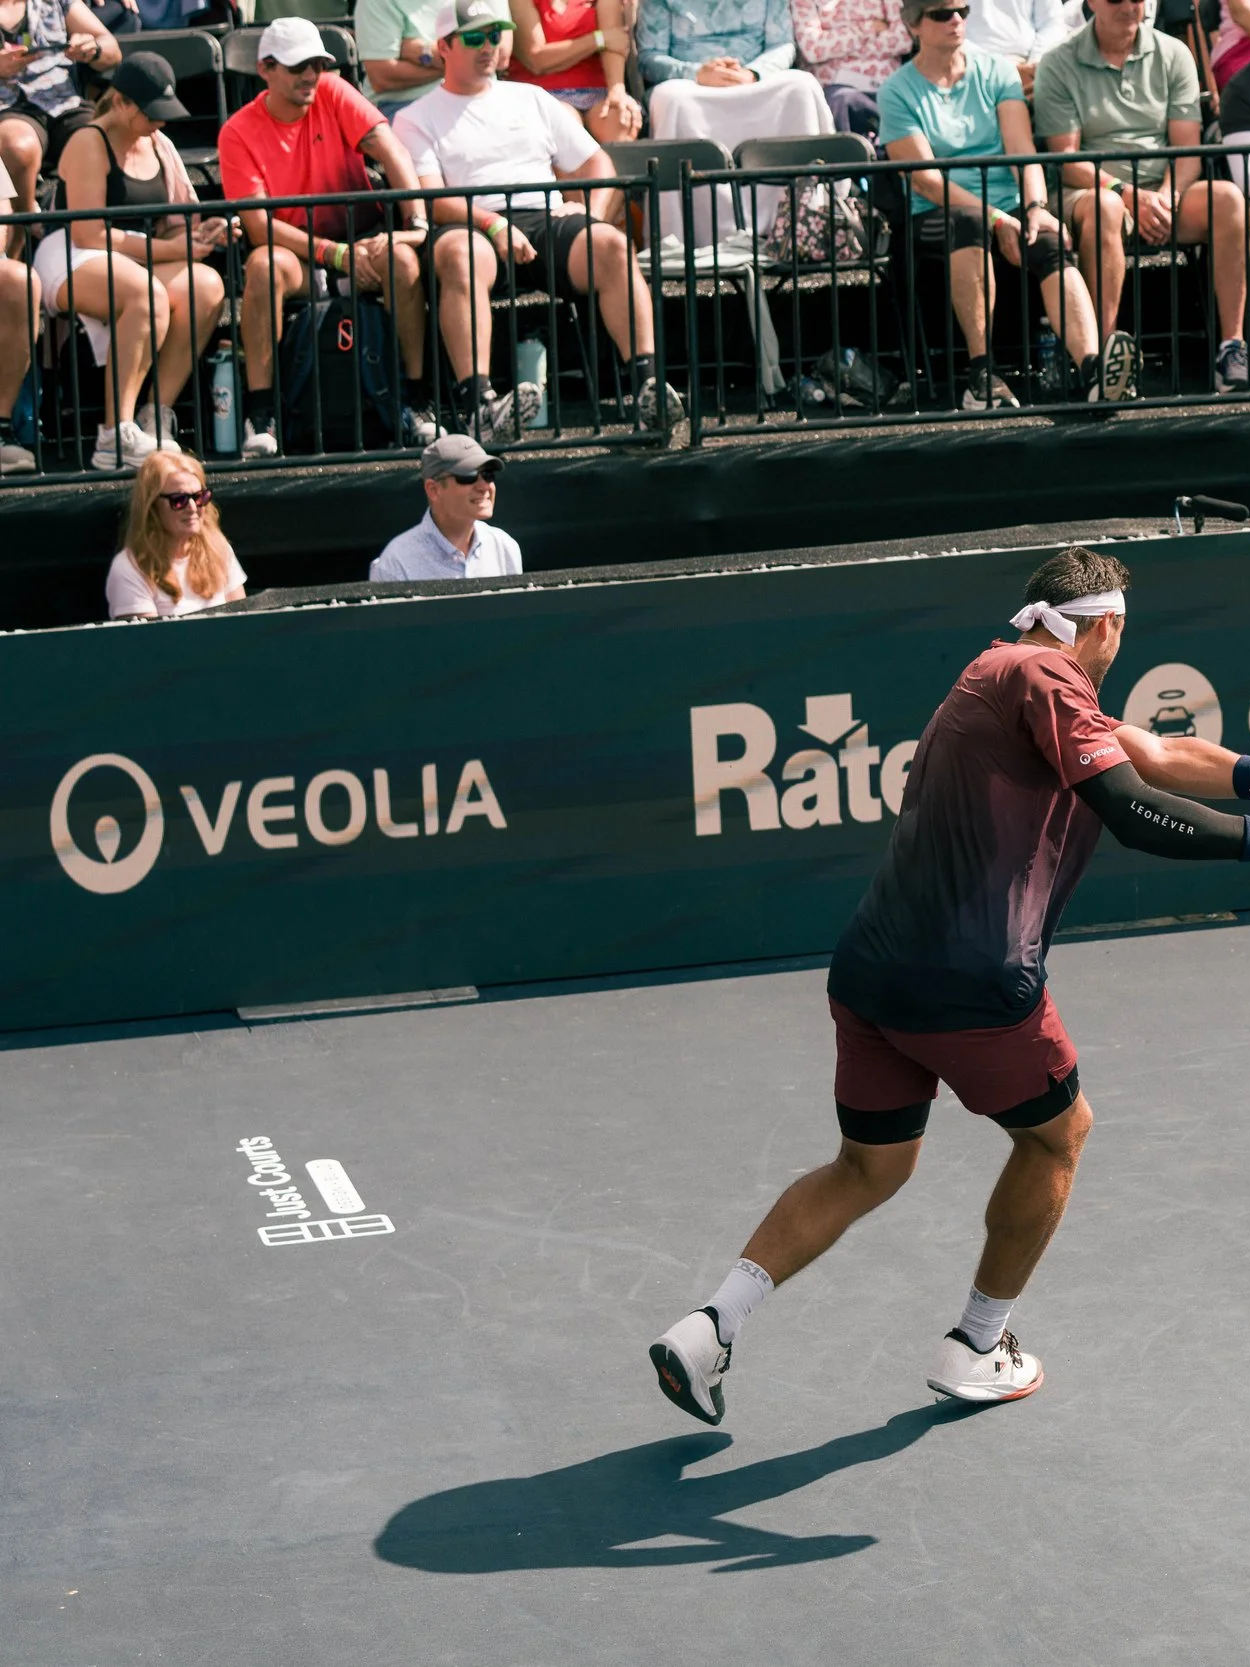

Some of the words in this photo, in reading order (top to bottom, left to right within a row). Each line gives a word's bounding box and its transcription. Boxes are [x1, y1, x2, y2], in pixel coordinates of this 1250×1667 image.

[179, 759, 508, 856] VEOLIA
[1130, 800, 1195, 836] LEORÊVER
[235, 1135, 292, 1186] Courts
[259, 1186, 312, 1220] Just
